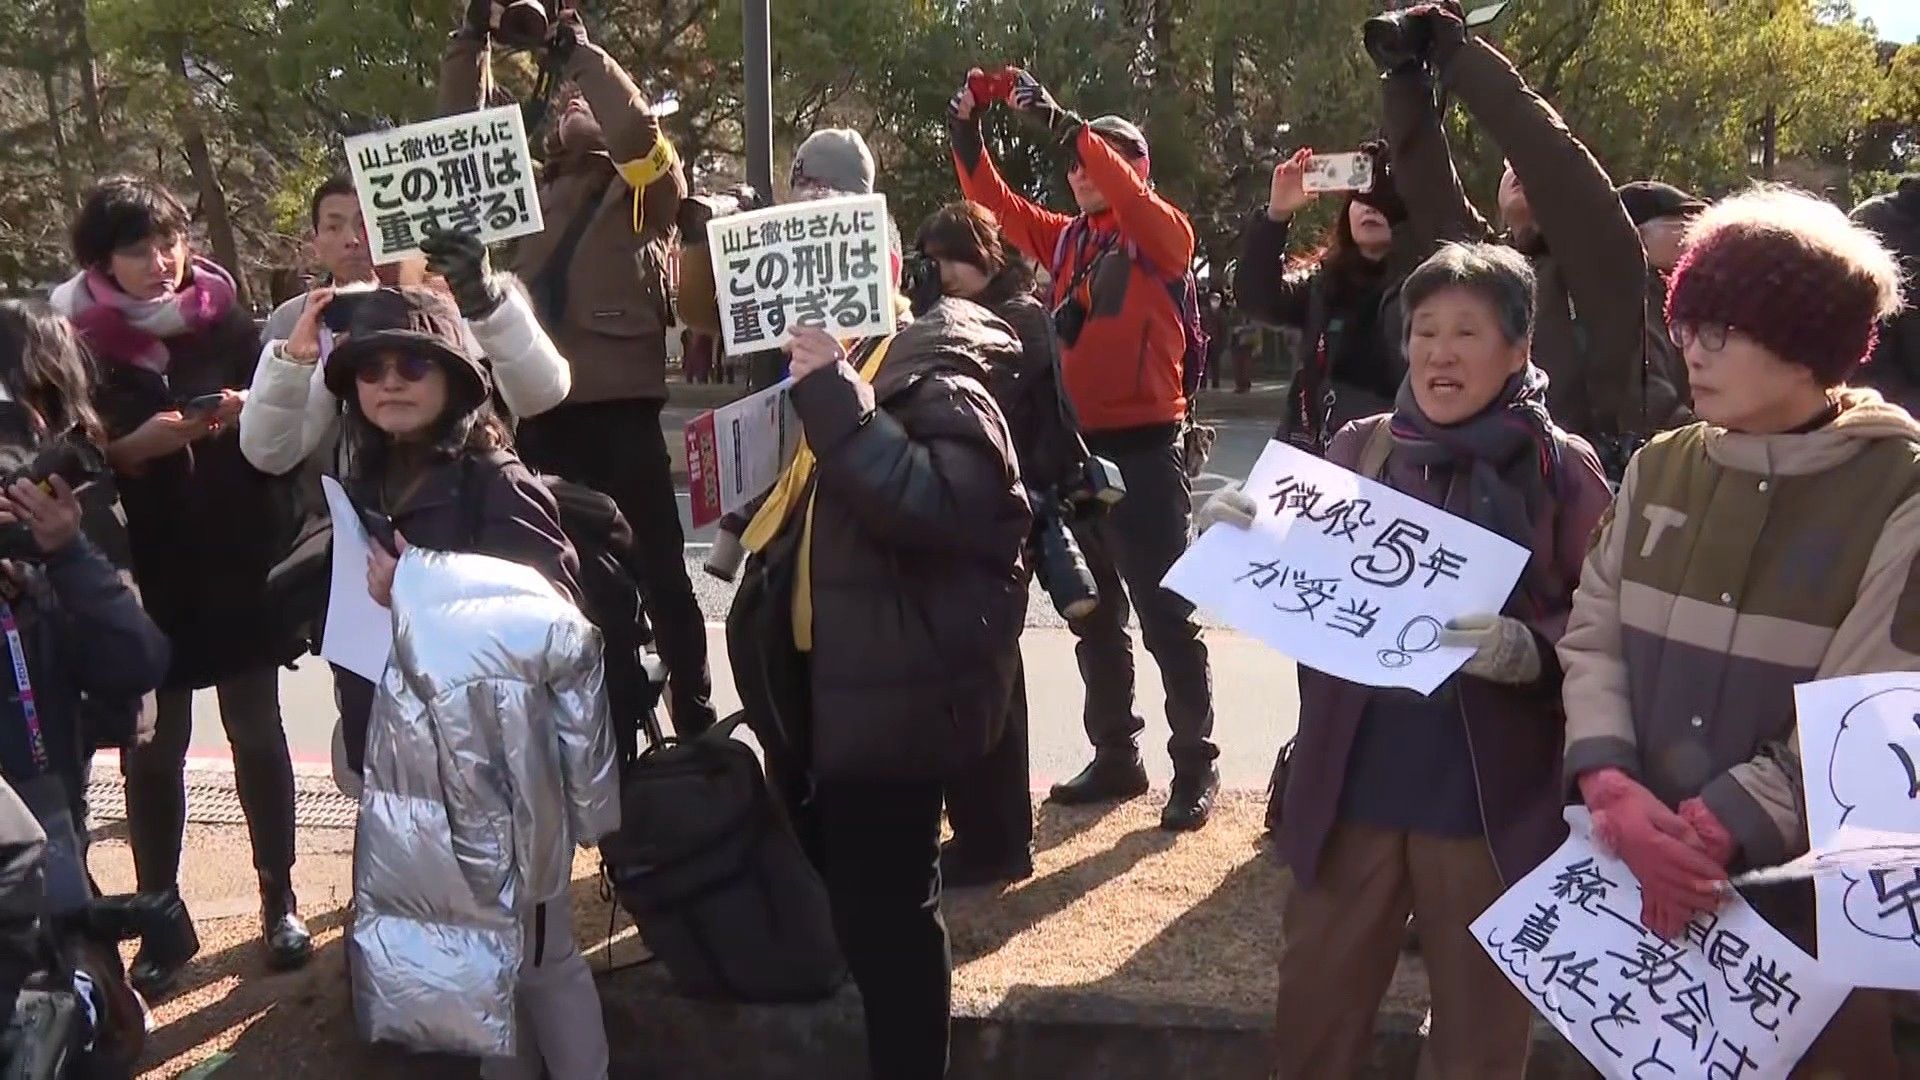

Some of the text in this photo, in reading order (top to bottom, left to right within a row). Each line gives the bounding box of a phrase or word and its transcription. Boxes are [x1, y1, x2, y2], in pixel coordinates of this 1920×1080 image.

[358, 121, 513, 172] 山上徹也さんに
[370, 147, 522, 210] この刑は
[722, 209, 876, 255] 山上徹也さんに
[728, 238, 879, 297] この刑は
